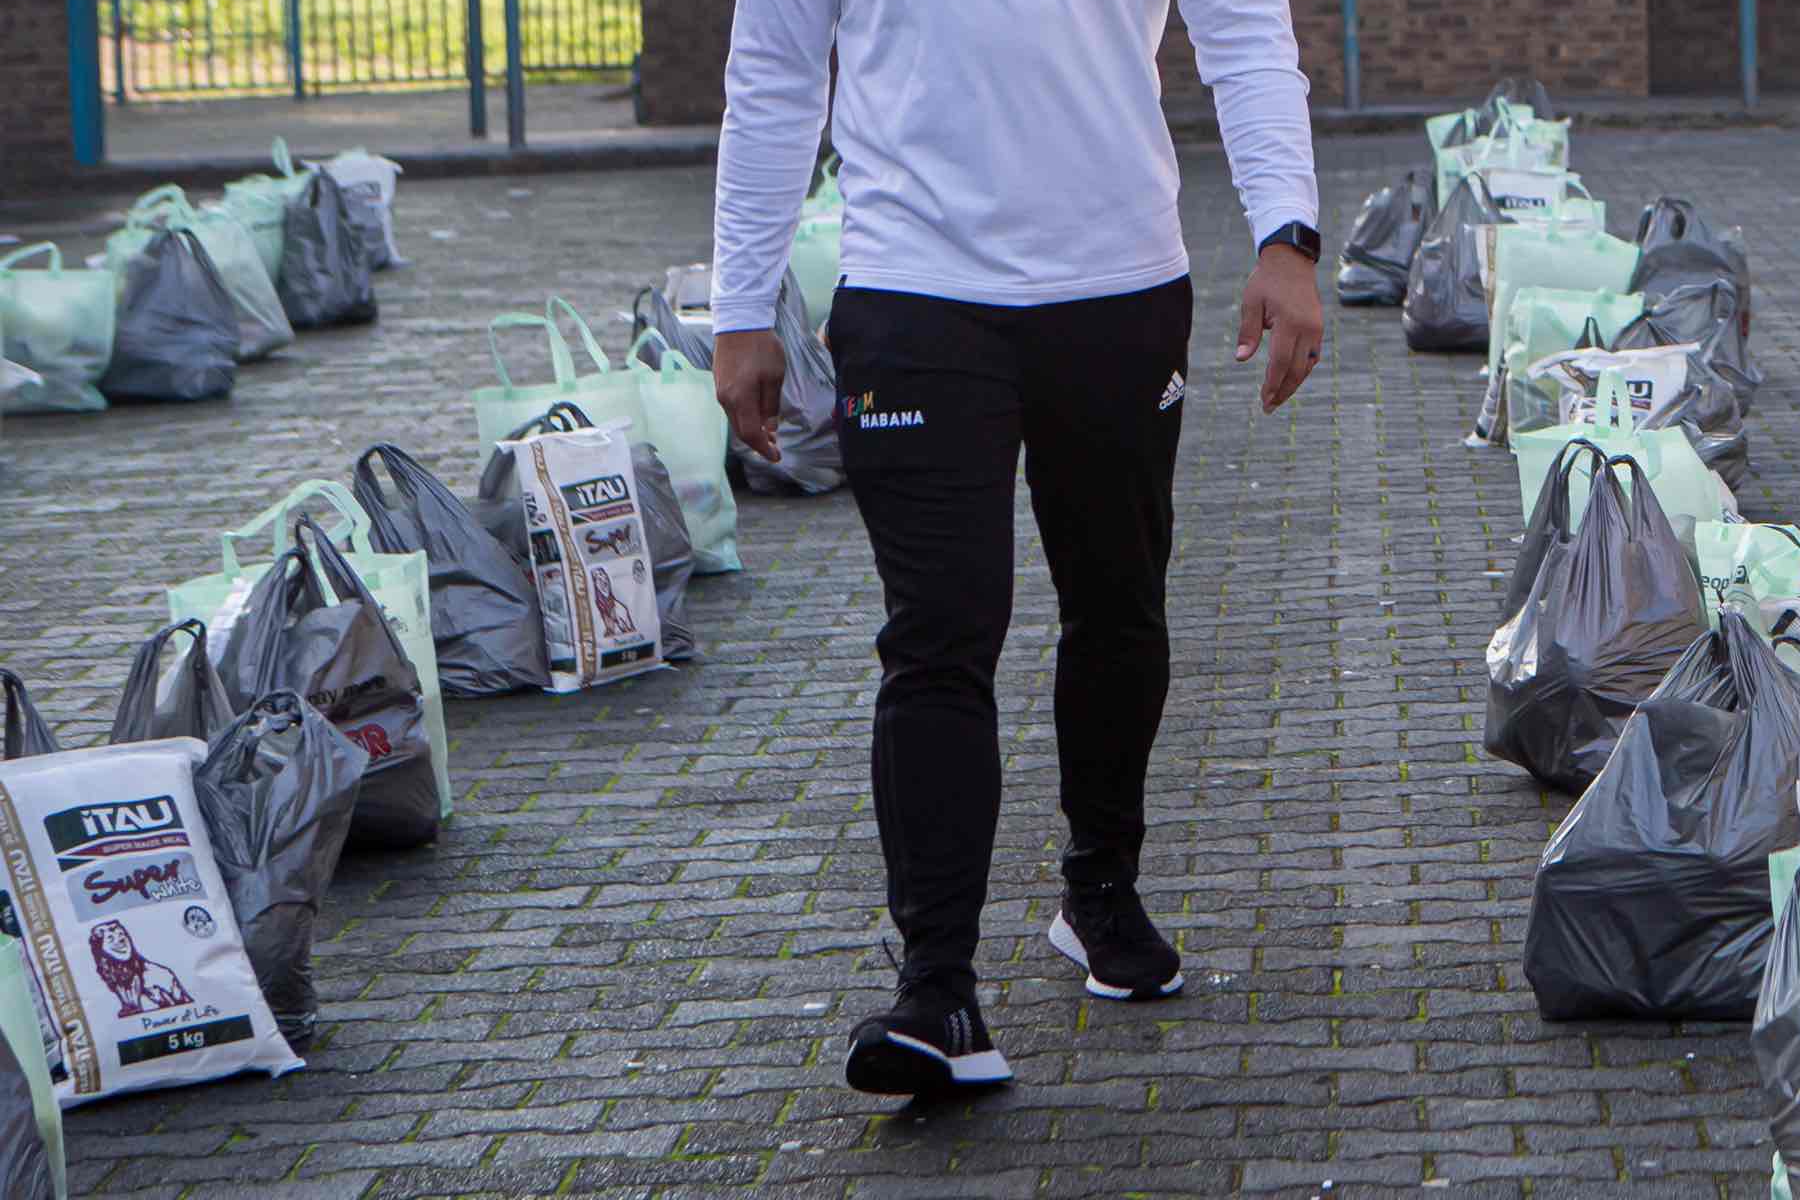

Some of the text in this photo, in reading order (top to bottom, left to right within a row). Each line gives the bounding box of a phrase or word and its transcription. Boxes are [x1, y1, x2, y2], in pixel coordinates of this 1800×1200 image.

[860, 410, 924, 429] HABANA
[168, 1031, 205, 1049] 5 kg
